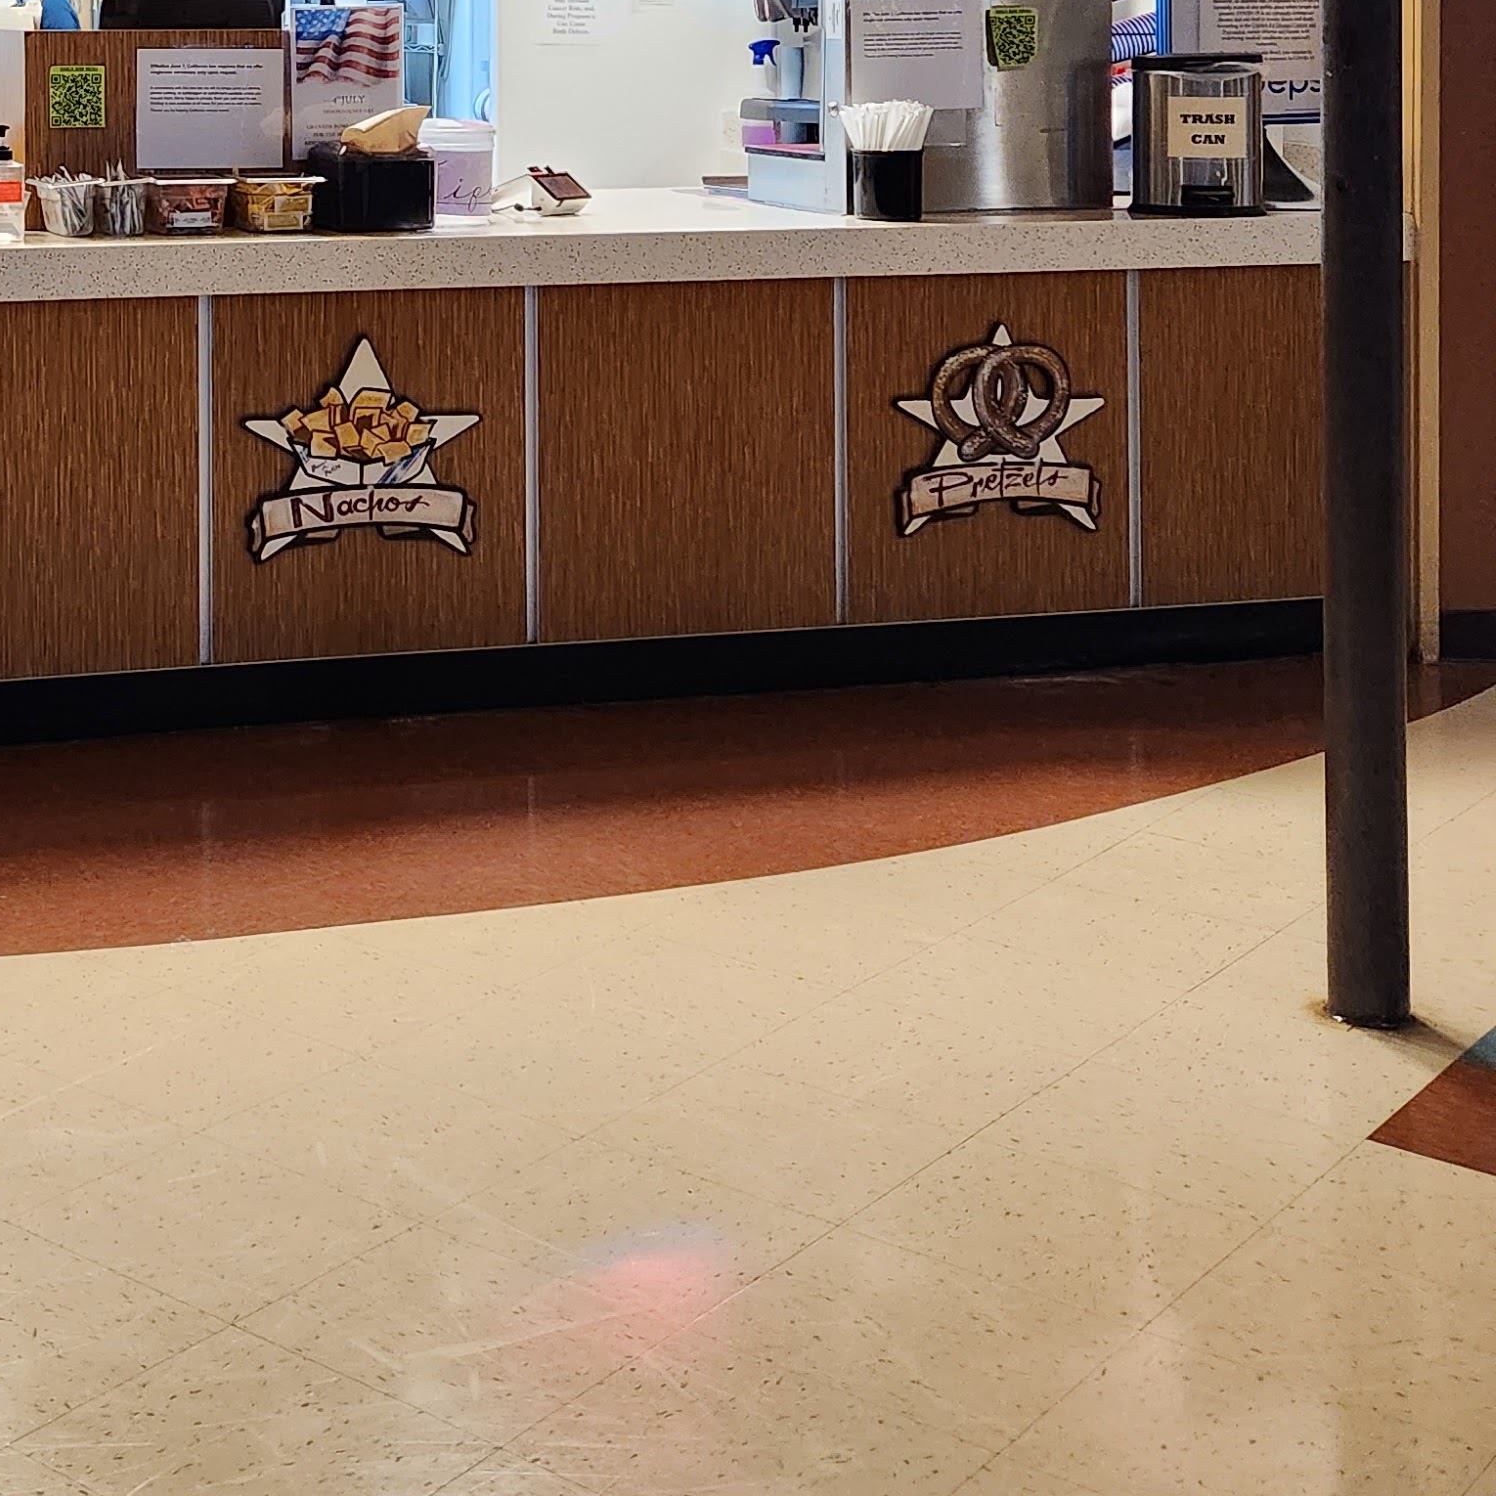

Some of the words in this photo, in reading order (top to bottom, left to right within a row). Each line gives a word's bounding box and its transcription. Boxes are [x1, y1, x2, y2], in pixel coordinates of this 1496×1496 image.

[341, 95, 365, 106] JULY
[1180, 114, 1235, 124] TRASH
[1191, 134, 1225, 145] CAN
[923, 457, 1068, 507] Pretzels
[291, 487, 430, 528] Nachos
